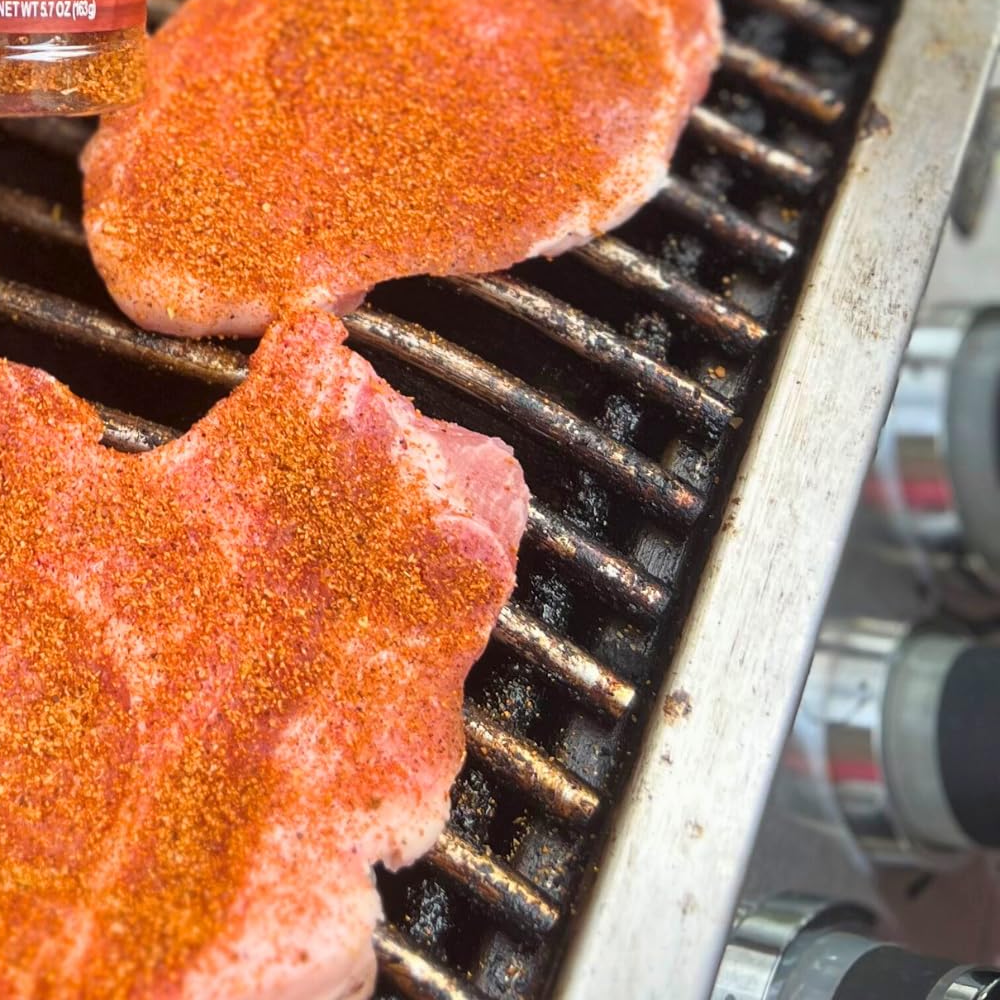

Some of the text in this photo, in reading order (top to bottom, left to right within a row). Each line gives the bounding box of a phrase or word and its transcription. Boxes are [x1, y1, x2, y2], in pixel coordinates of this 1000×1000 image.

[21, 0, 39, 17] WT
[40, 0, 55, 17] 5.7
[56, 0, 72, 17] OZ
